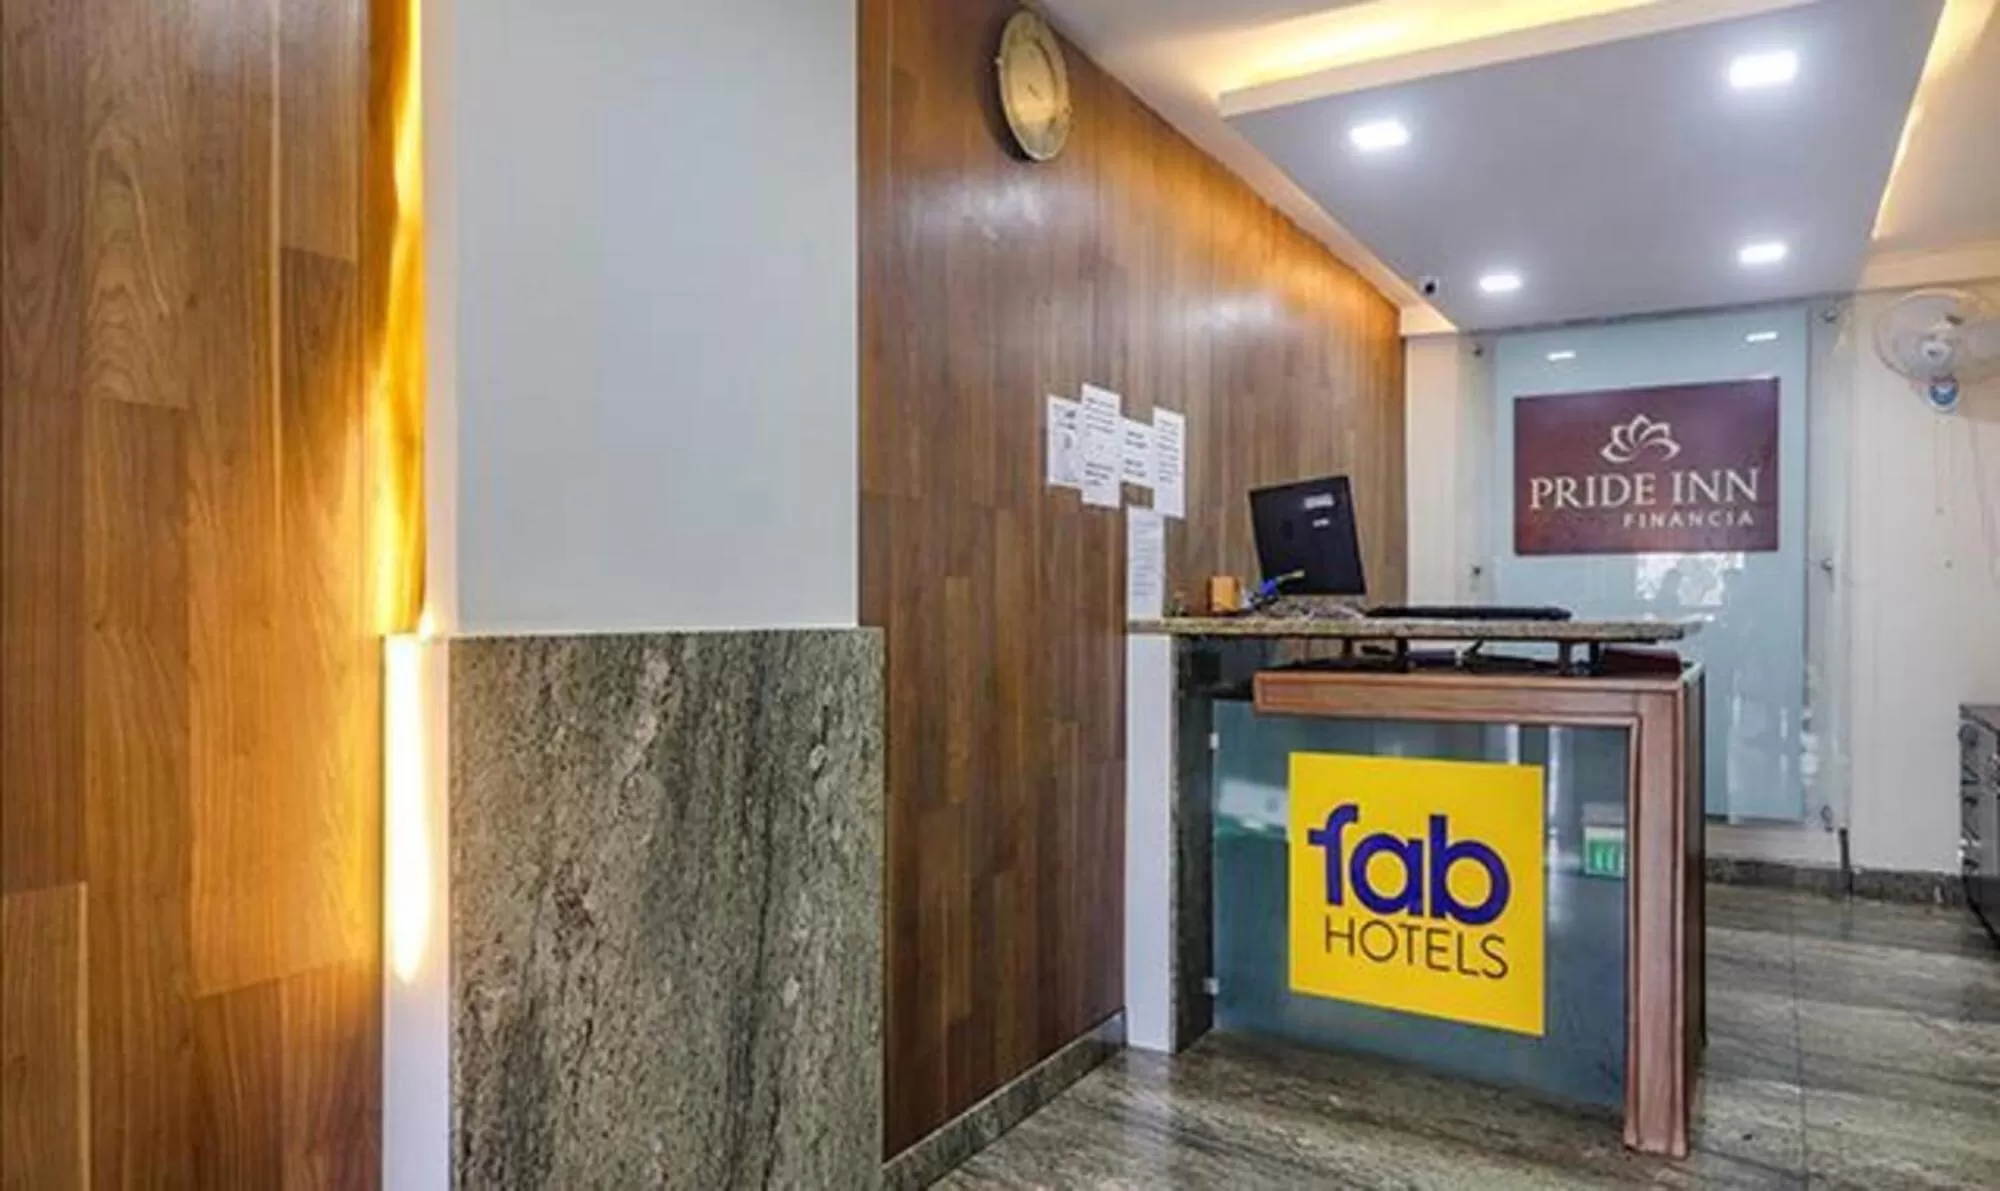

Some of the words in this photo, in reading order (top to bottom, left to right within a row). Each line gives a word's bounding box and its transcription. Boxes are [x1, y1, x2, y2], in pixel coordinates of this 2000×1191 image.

[1528, 471, 1657, 511] PRIDE
[1671, 467, 1761, 505] INN
[1622, 509, 1755, 529] FINANCIA
[1306, 803, 1512, 926] fab
[1324, 914, 1510, 980] HOTELS
